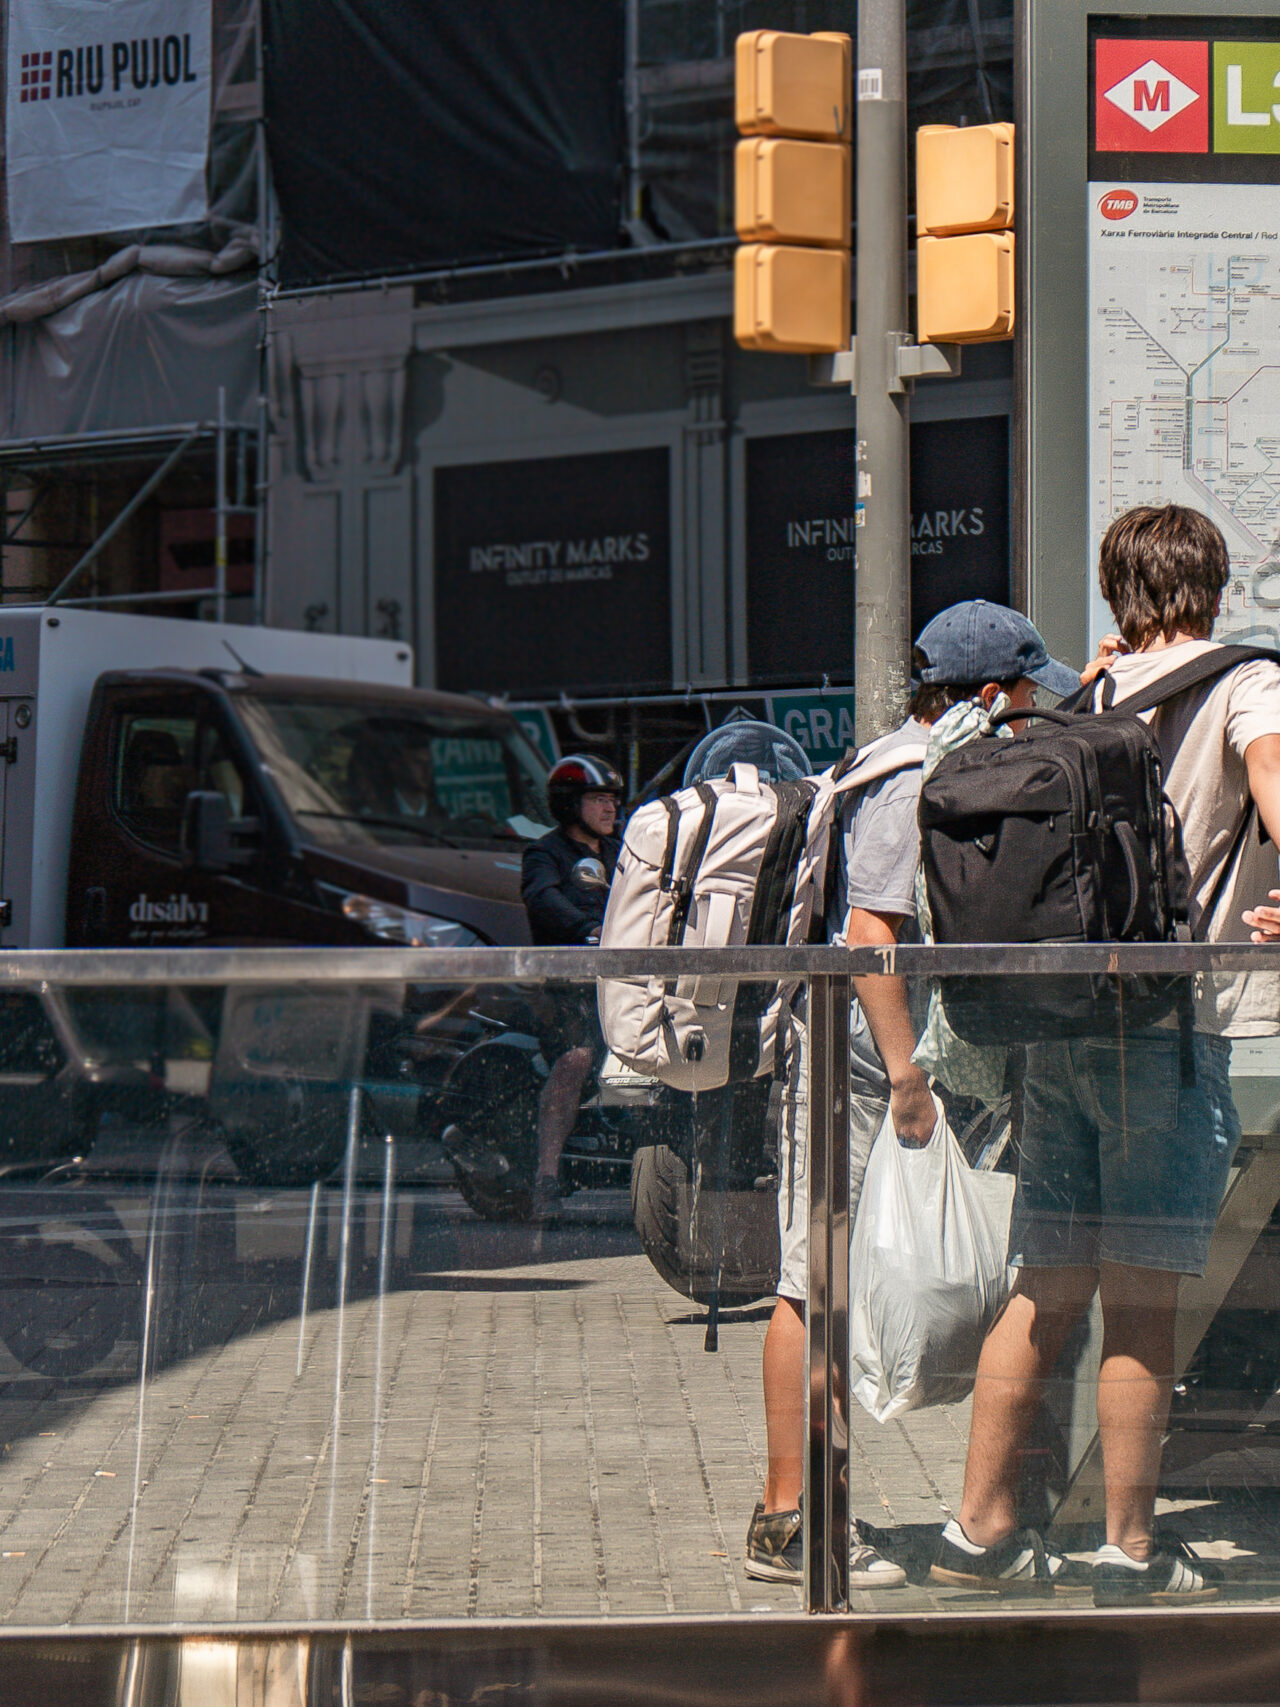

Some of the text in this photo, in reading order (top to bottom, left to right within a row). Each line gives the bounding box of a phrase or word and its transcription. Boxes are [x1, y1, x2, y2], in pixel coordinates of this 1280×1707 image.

[56, 33, 197, 99] RIU PUJOL
[1133, 79, 1170, 112] M
[1106, 199, 1135, 211] TMB
[1100, 229, 1126, 238] Xarxa
[1177, 230, 1219, 240] Integrada
[1221, 231, 1253, 239] Central
[1261, 231, 1278, 240] Red
[787, 507, 985, 548] INFINI ARKS
[469, 532, 650, 572] INFINITY MARKS
[827, 540, 944, 562] OUT RCAS
